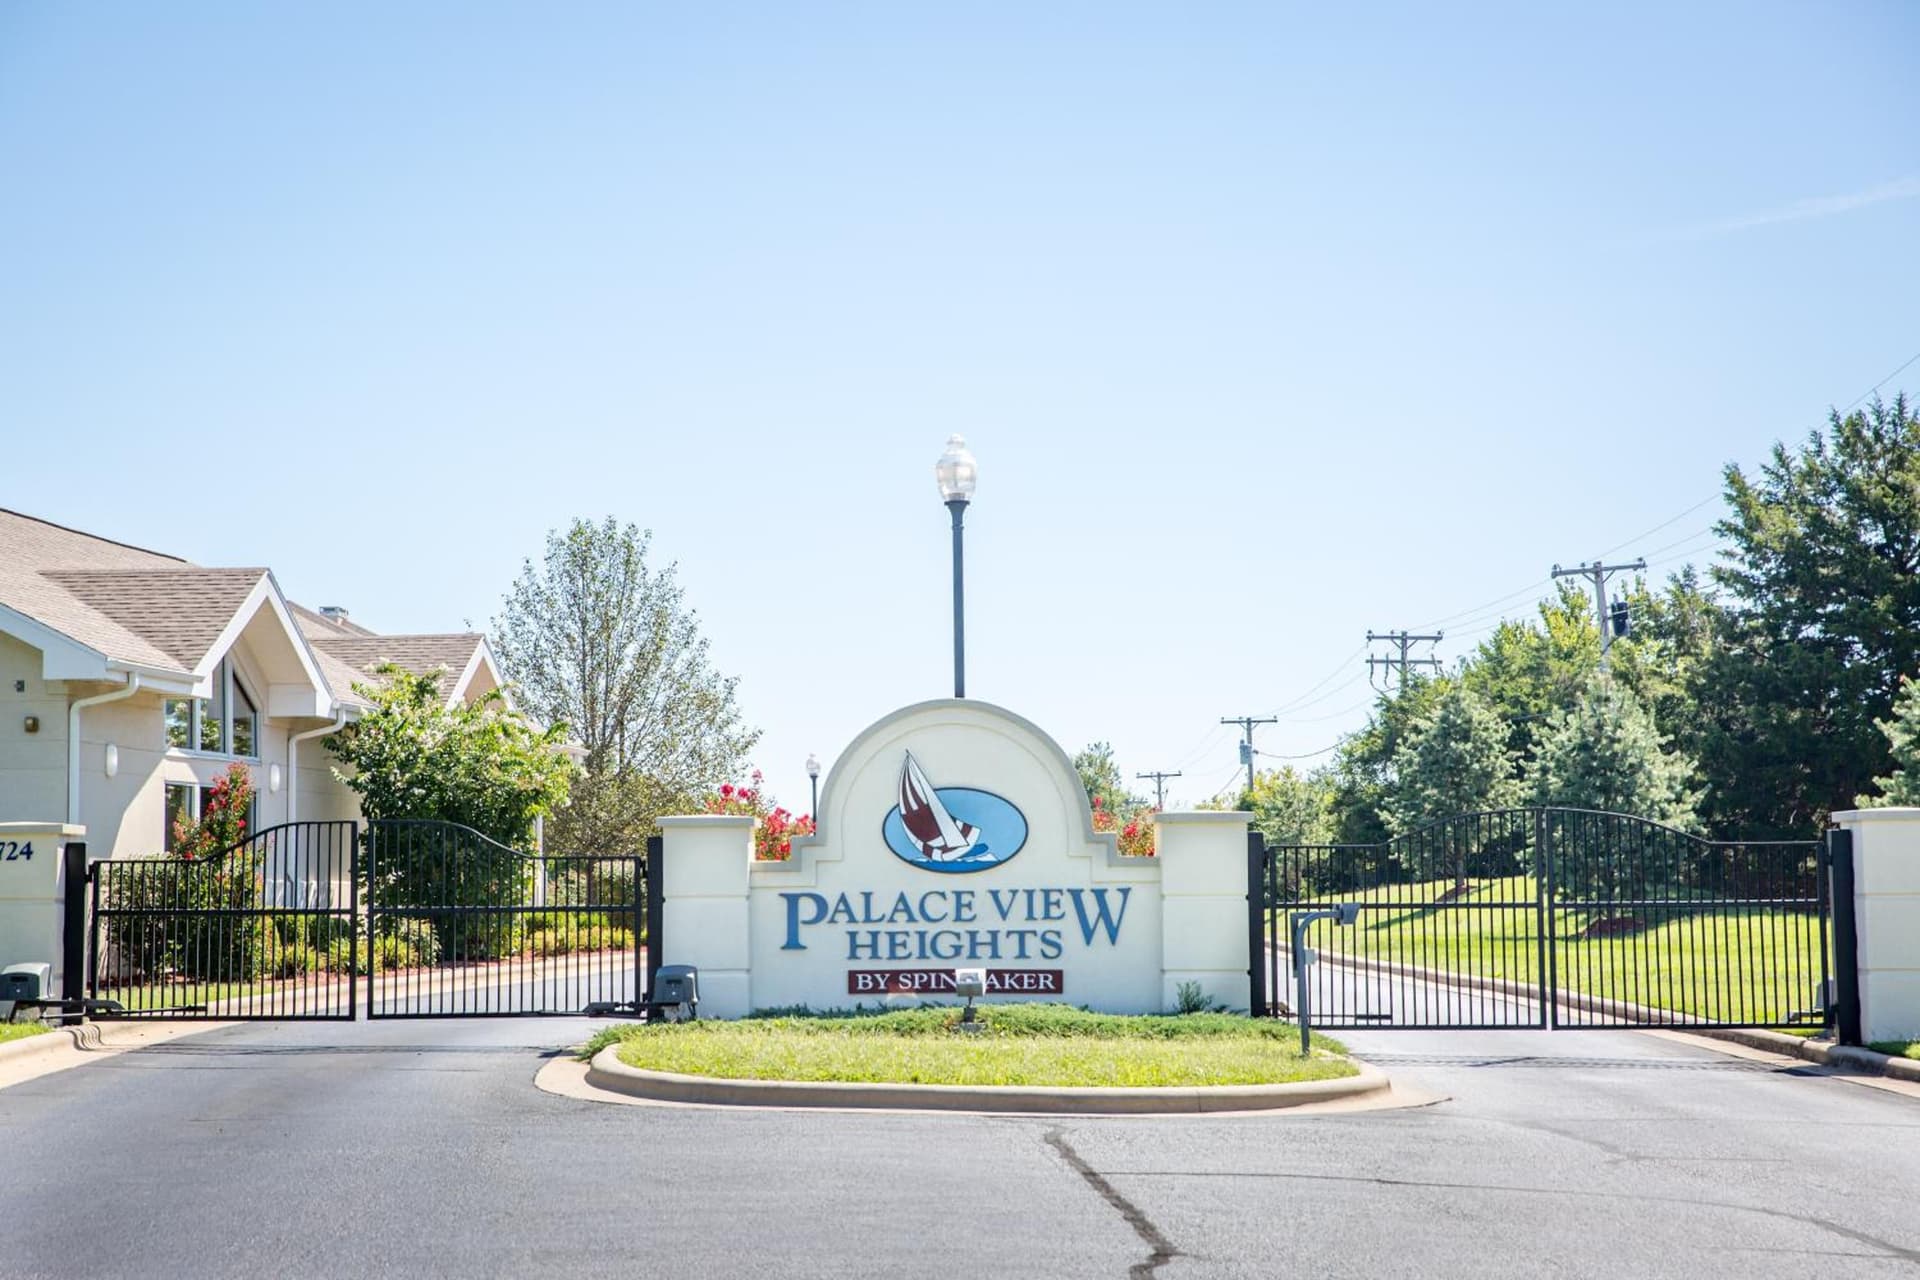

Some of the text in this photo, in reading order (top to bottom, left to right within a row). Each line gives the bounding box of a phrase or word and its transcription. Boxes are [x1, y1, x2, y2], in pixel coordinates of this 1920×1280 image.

[780, 887, 1132, 950] PALACE VIEW
[846, 930, 1063, 960] HEIGHTS
[856, 973, 1055, 990] BY SPINAKER
